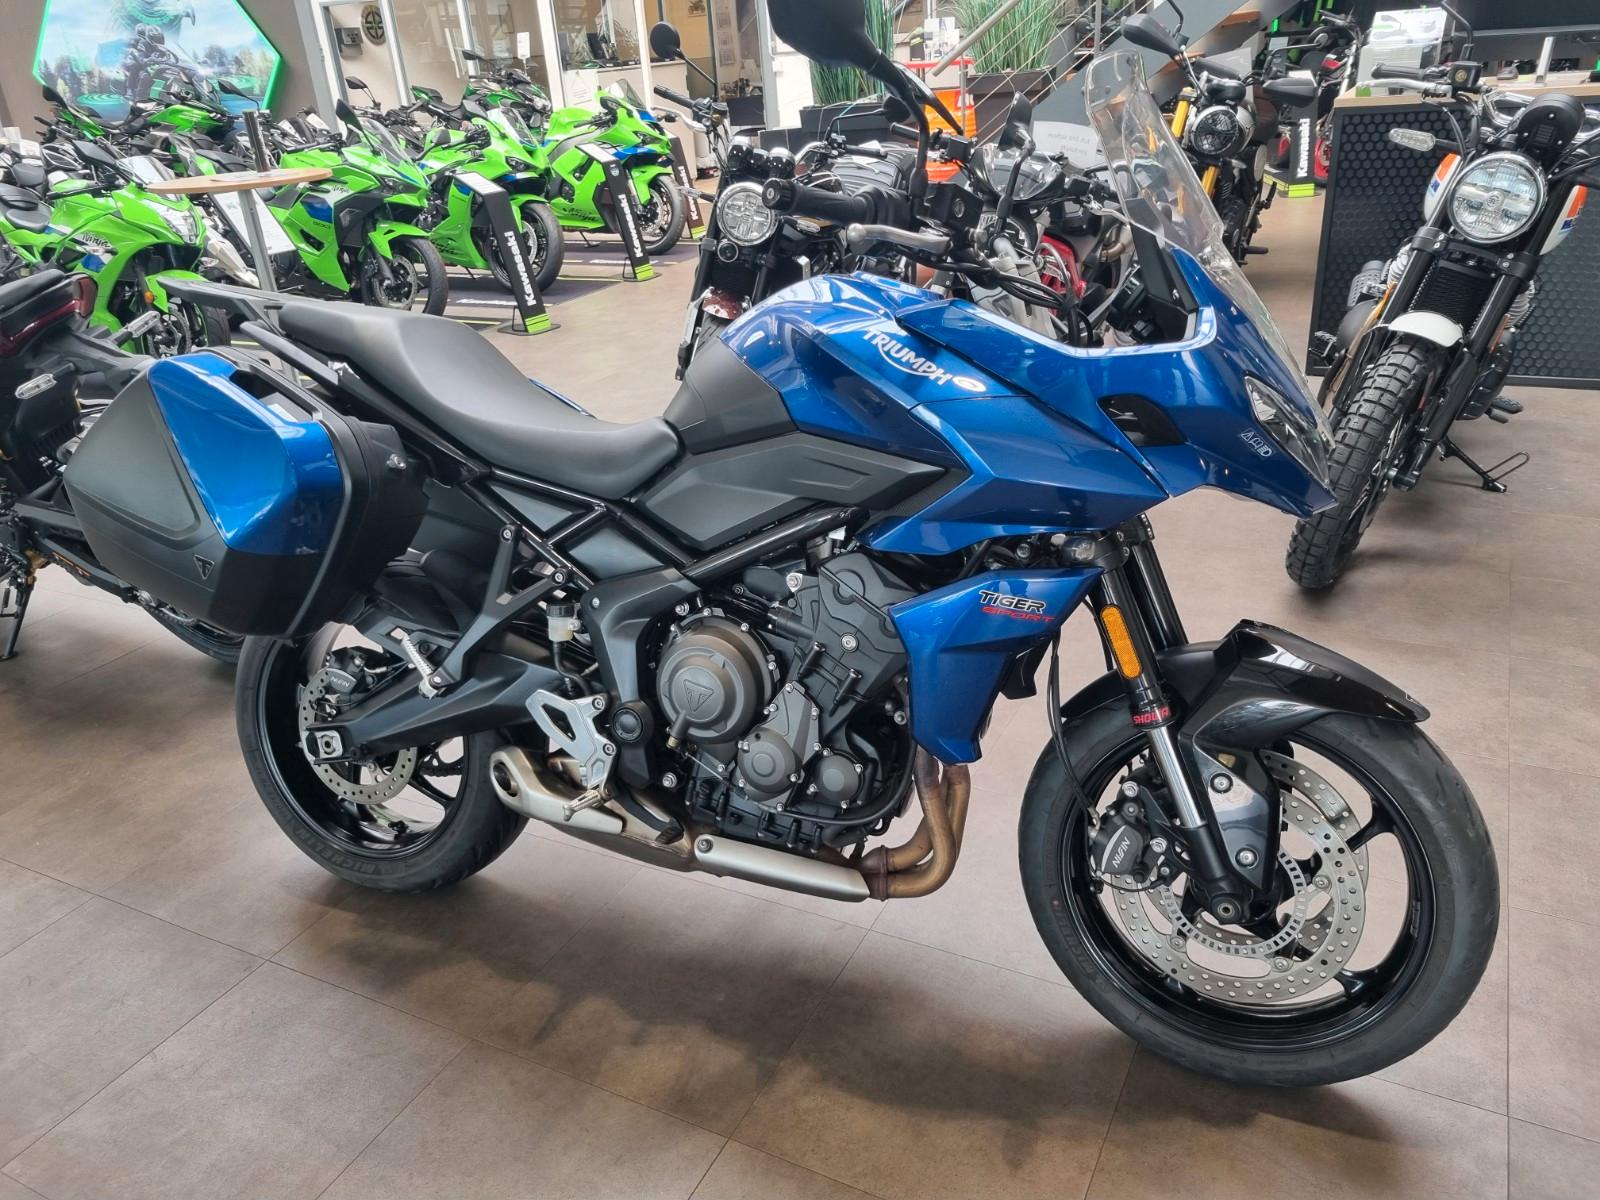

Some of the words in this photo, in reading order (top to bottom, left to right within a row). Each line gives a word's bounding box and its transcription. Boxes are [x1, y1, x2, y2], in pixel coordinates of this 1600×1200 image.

[1296, 118, 1311, 179] Kawasaki
[617, 194, 644, 258] Kawasaki
[504, 230, 536, 306] Kawasaki
[862, 327, 953, 385] TRIUMPH
[979, 590, 1046, 614] TIGER
[981, 605, 1055, 622] SPORT
